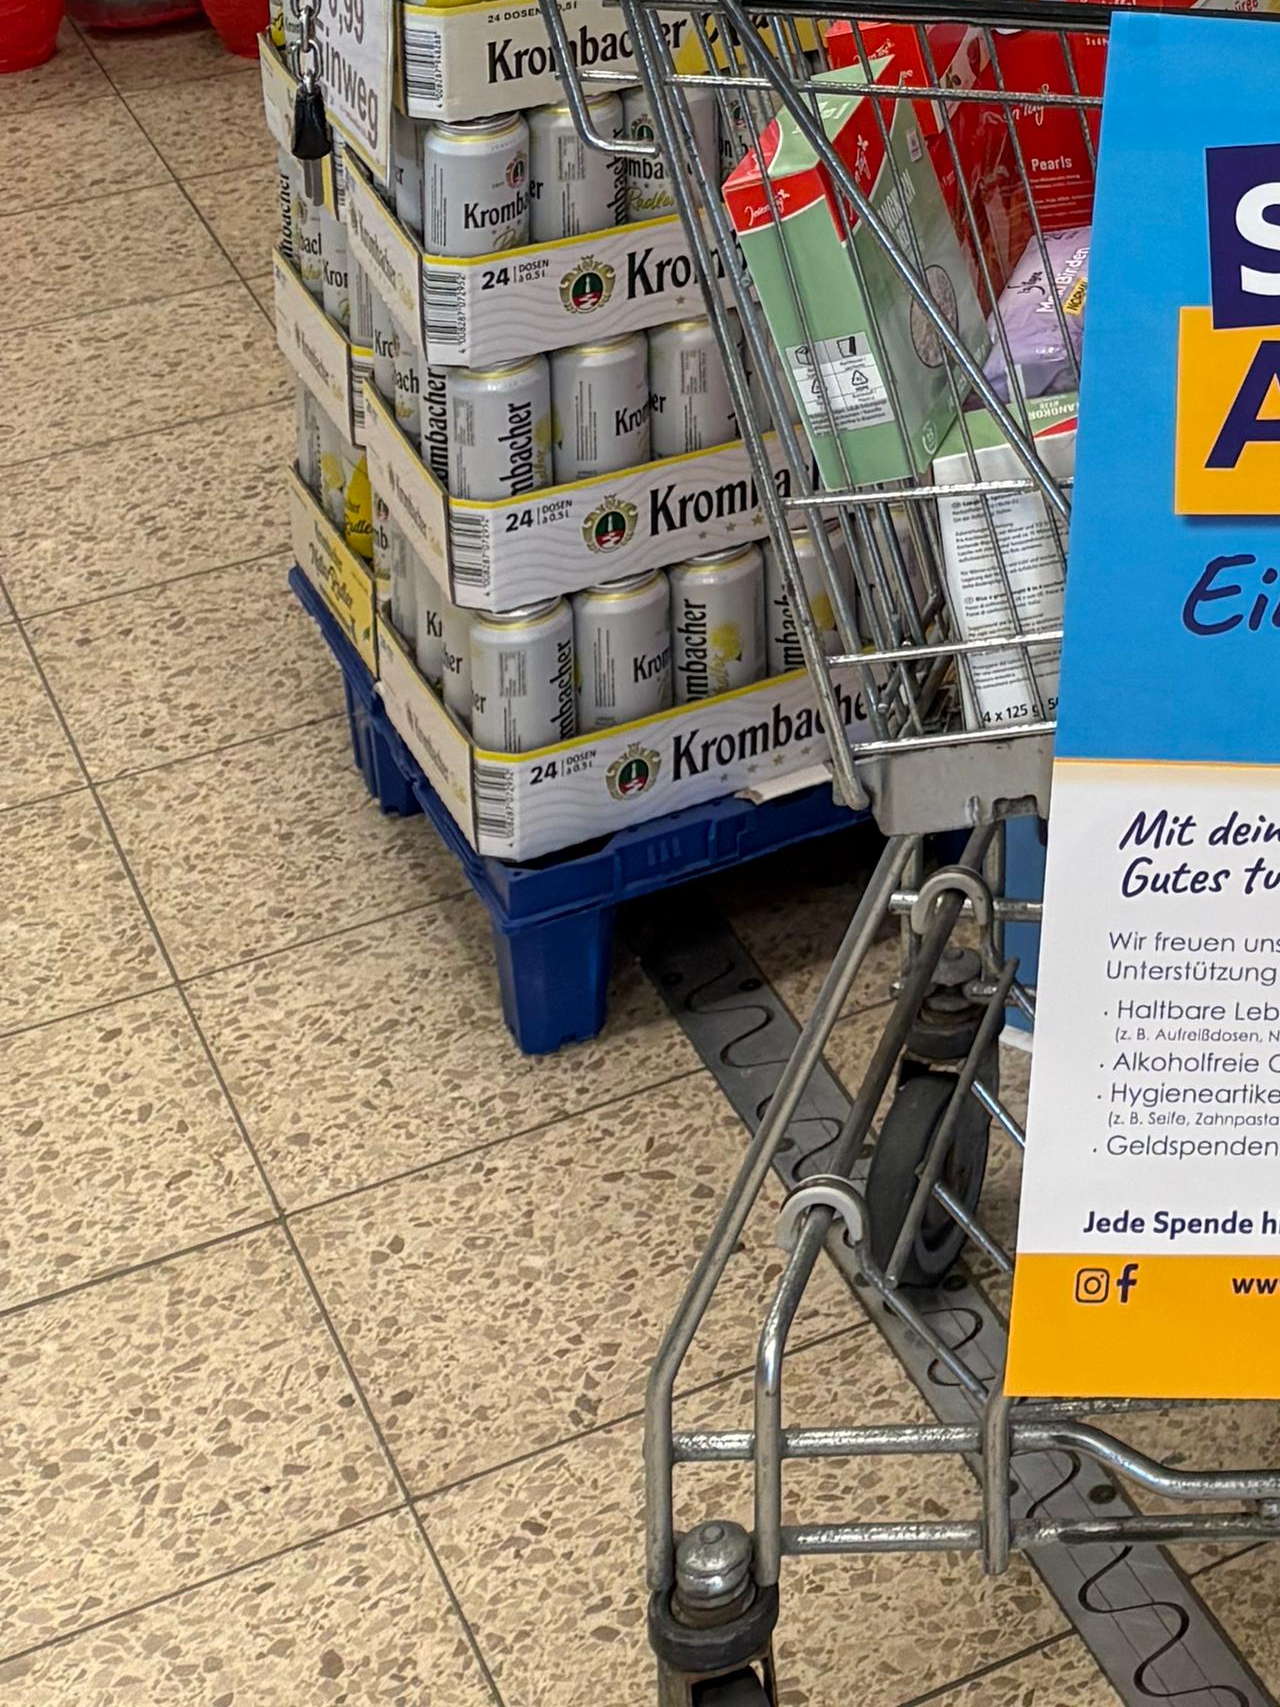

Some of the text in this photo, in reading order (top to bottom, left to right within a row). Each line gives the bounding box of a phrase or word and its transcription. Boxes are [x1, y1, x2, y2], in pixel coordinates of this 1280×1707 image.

[487, 14, 500, 23] 24
[318, 24, 378, 149] inweg
[1031, 155, 1073, 173] Pearls
[519, 259, 549, 273] DOSEN
[482, 267, 510, 291] 24
[498, 401, 534, 496] mbacher
[542, 499, 573, 514] DOSEN
[505, 509, 533, 532] 24
[983, 708, 991, 725] 4
[995, 710, 1003, 721] x
[1006, 703, 1028, 720] 125
[567, 749, 597, 765] DOSEN
[530, 761, 558, 785] 24
[1119, 809, 1195, 851] Mit
[1121, 856, 1229, 899] Gutes
[1109, 931, 1147, 953] Wir
[1155, 931, 1236, 954] freuen
[1105, 960, 1277, 987] Unterstützung
[1116, 999, 1226, 1021] Haltbare
[1114, 1027, 1132, 1043] (z.
[1137, 1028, 1150, 1042] B.
[1155, 1028, 1263, 1045] Aufreißdosen,
[1112, 1051, 1260, 1075] Alkoholfreie
[1107, 1111, 1125, 1127] (z.
[1129, 1112, 1143, 1126] B.
[1147, 1111, 1190, 1128] Seife,
[1195, 1112, 1280, 1129] Zahnpasta
[1106, 1135, 1279, 1162] Geldspenden
[1082, 1210, 1145, 1237] Jede
[1153, 1211, 1254, 1240] Spende
